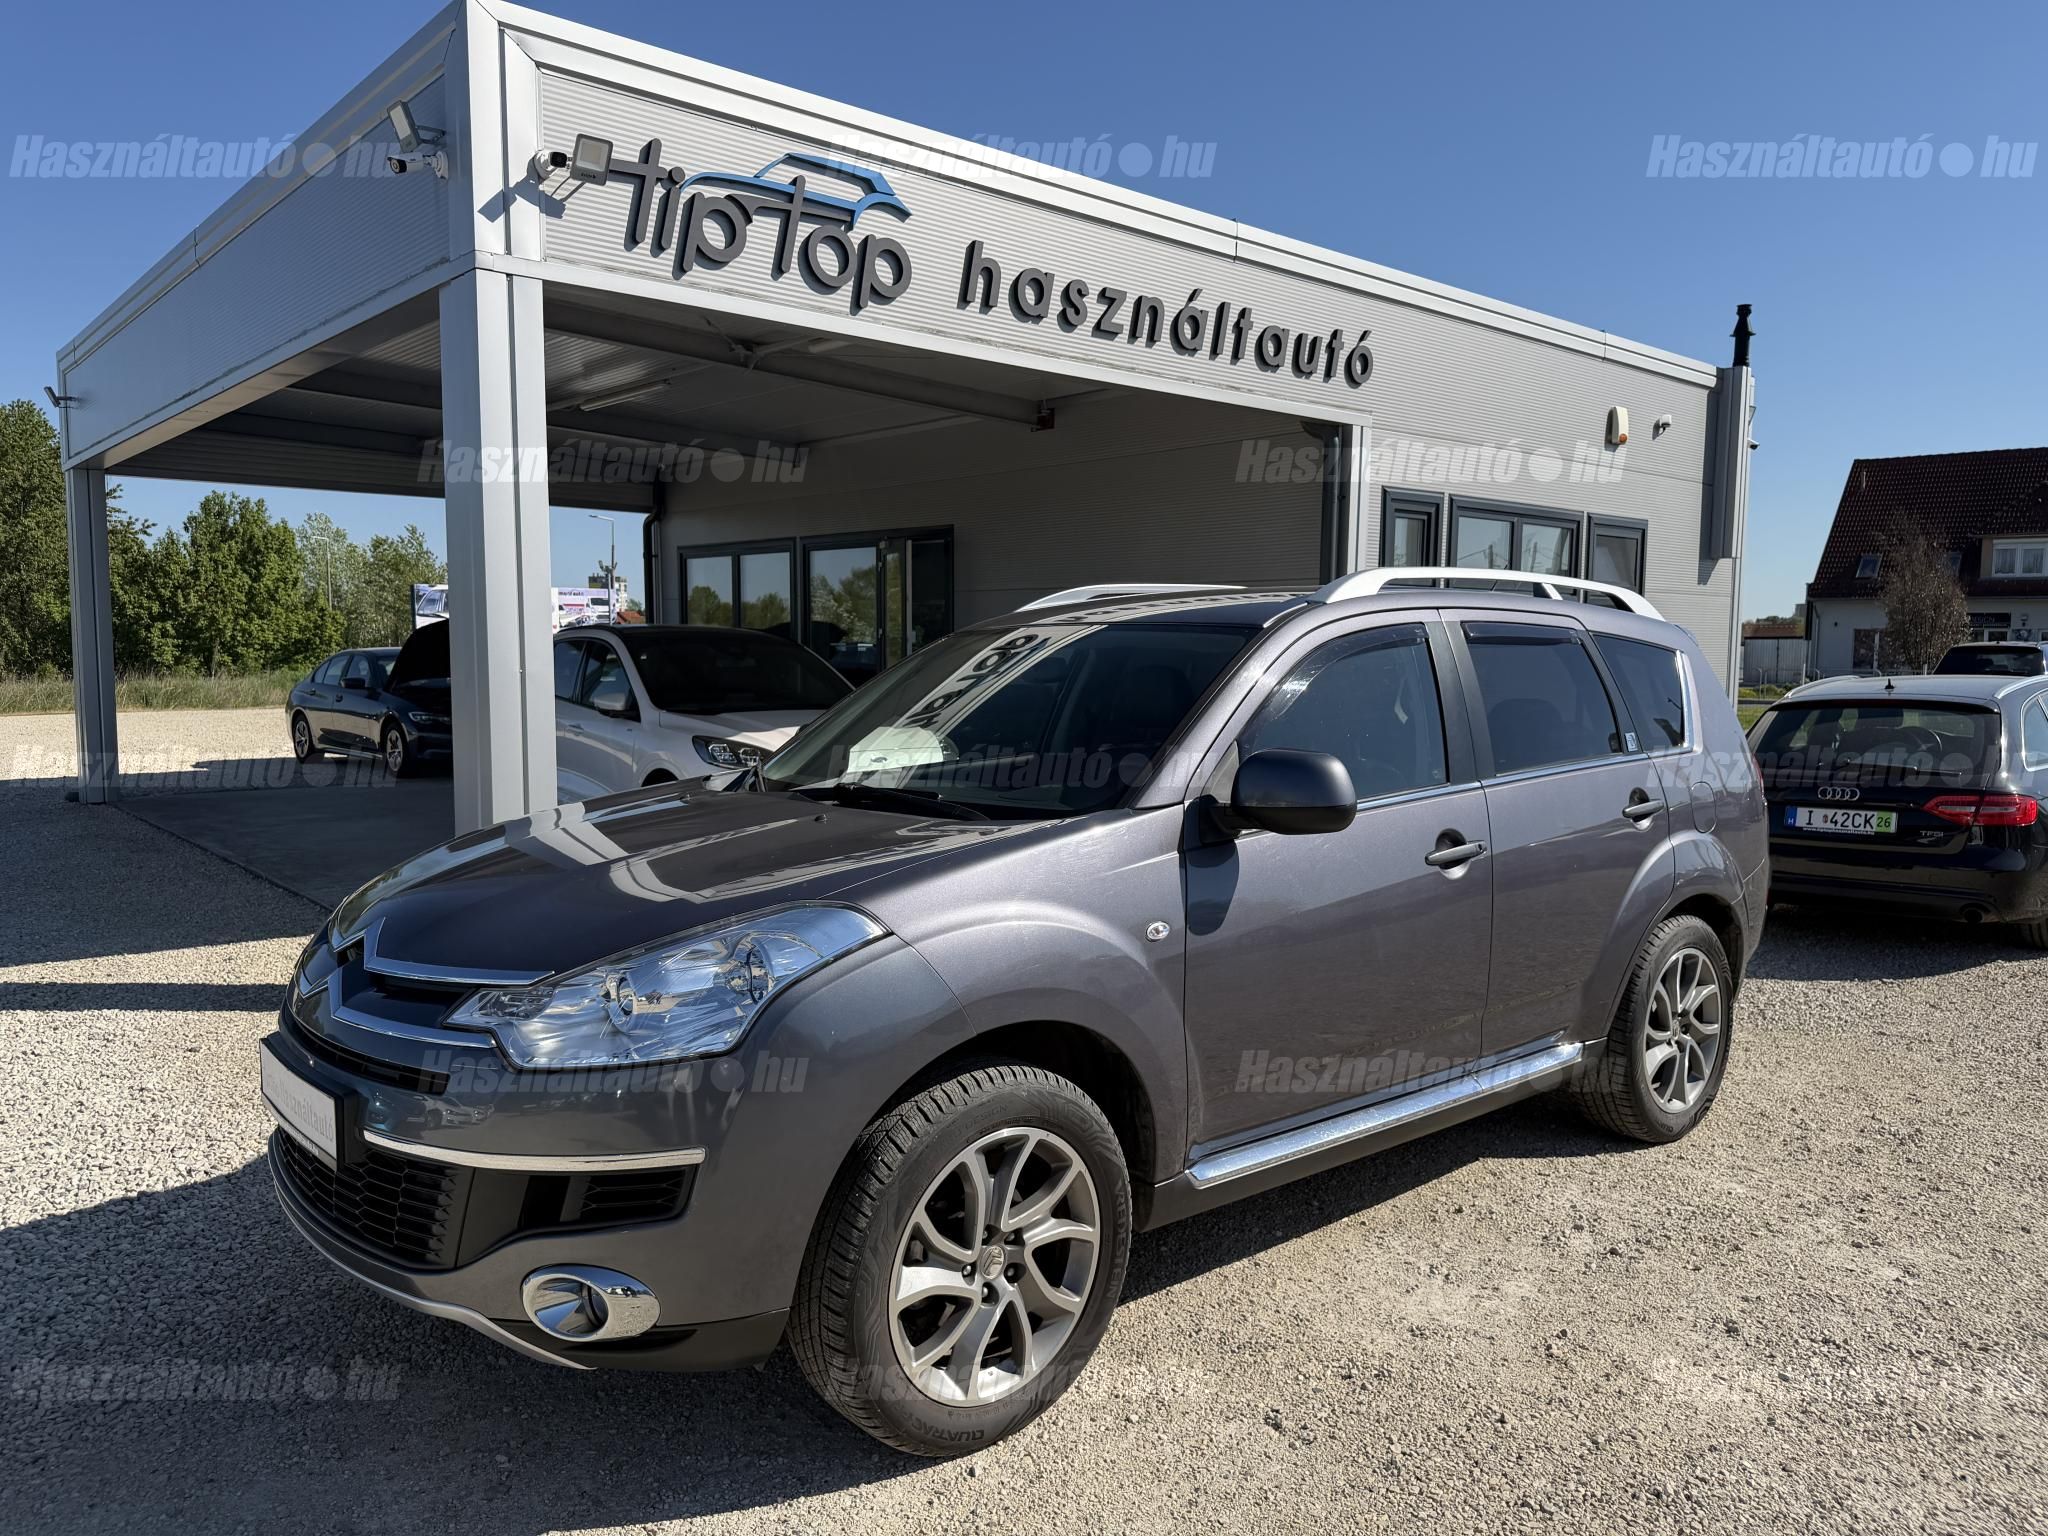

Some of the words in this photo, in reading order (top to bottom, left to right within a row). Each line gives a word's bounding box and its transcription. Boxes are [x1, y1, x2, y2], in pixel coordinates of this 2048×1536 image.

[957, 239, 1375, 387] használtautó
[1829, 811, 1876, 830] 42CK
[1105, 1178, 1128, 1299] VREDESTEIN
